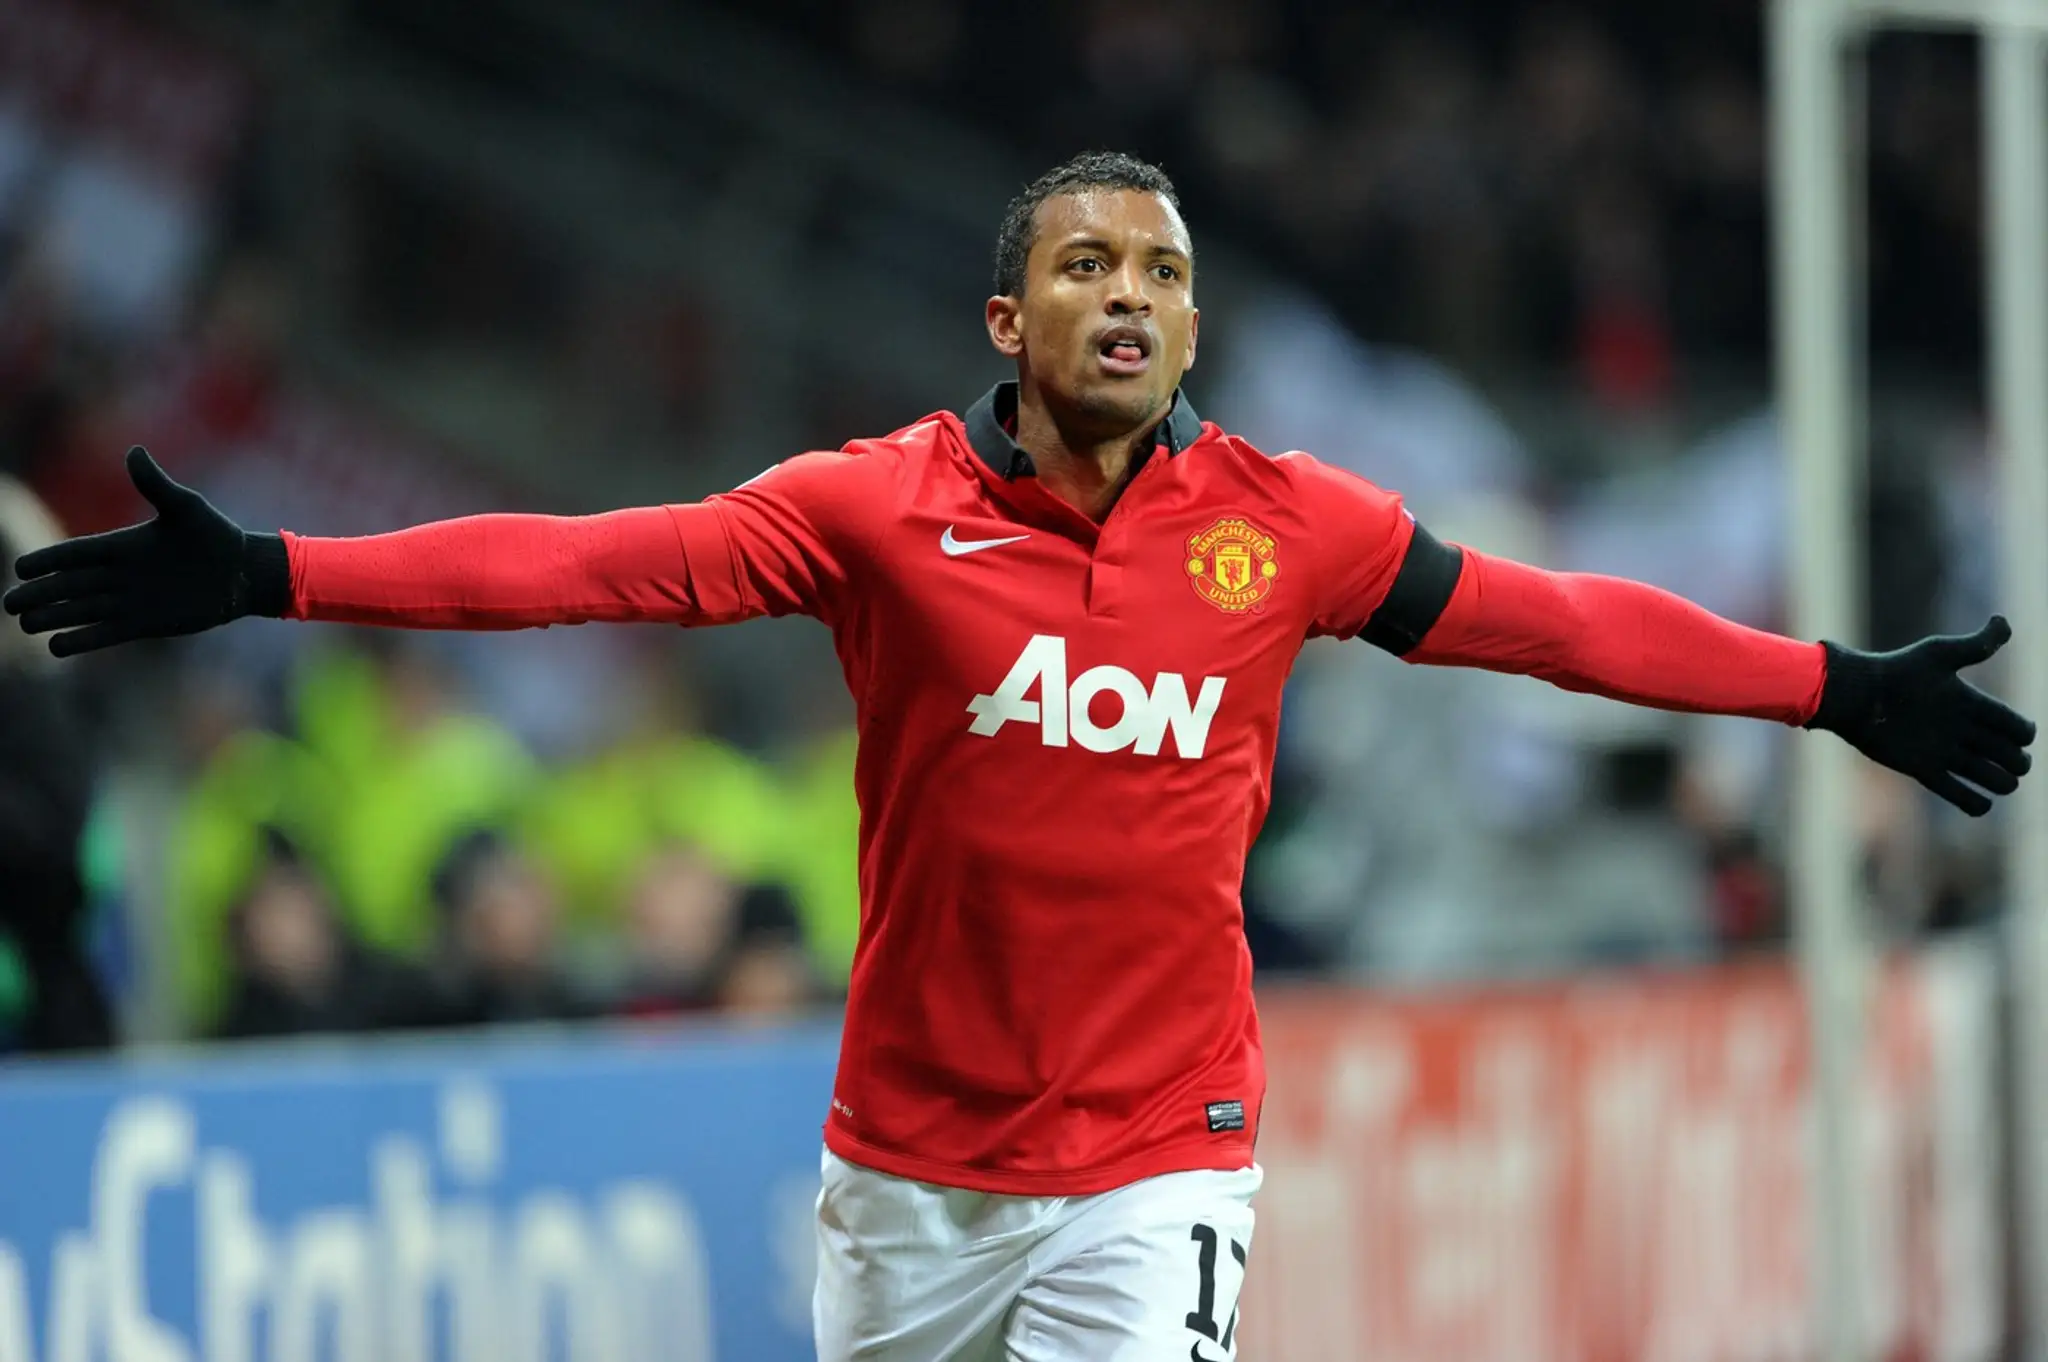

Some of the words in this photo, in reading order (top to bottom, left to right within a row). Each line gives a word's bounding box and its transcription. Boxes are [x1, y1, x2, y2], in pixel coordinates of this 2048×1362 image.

[1198, 526, 1269, 556] MANCHESTER
[1208, 586, 1259, 604] UNITED
[965, 633, 1228, 759] AON
